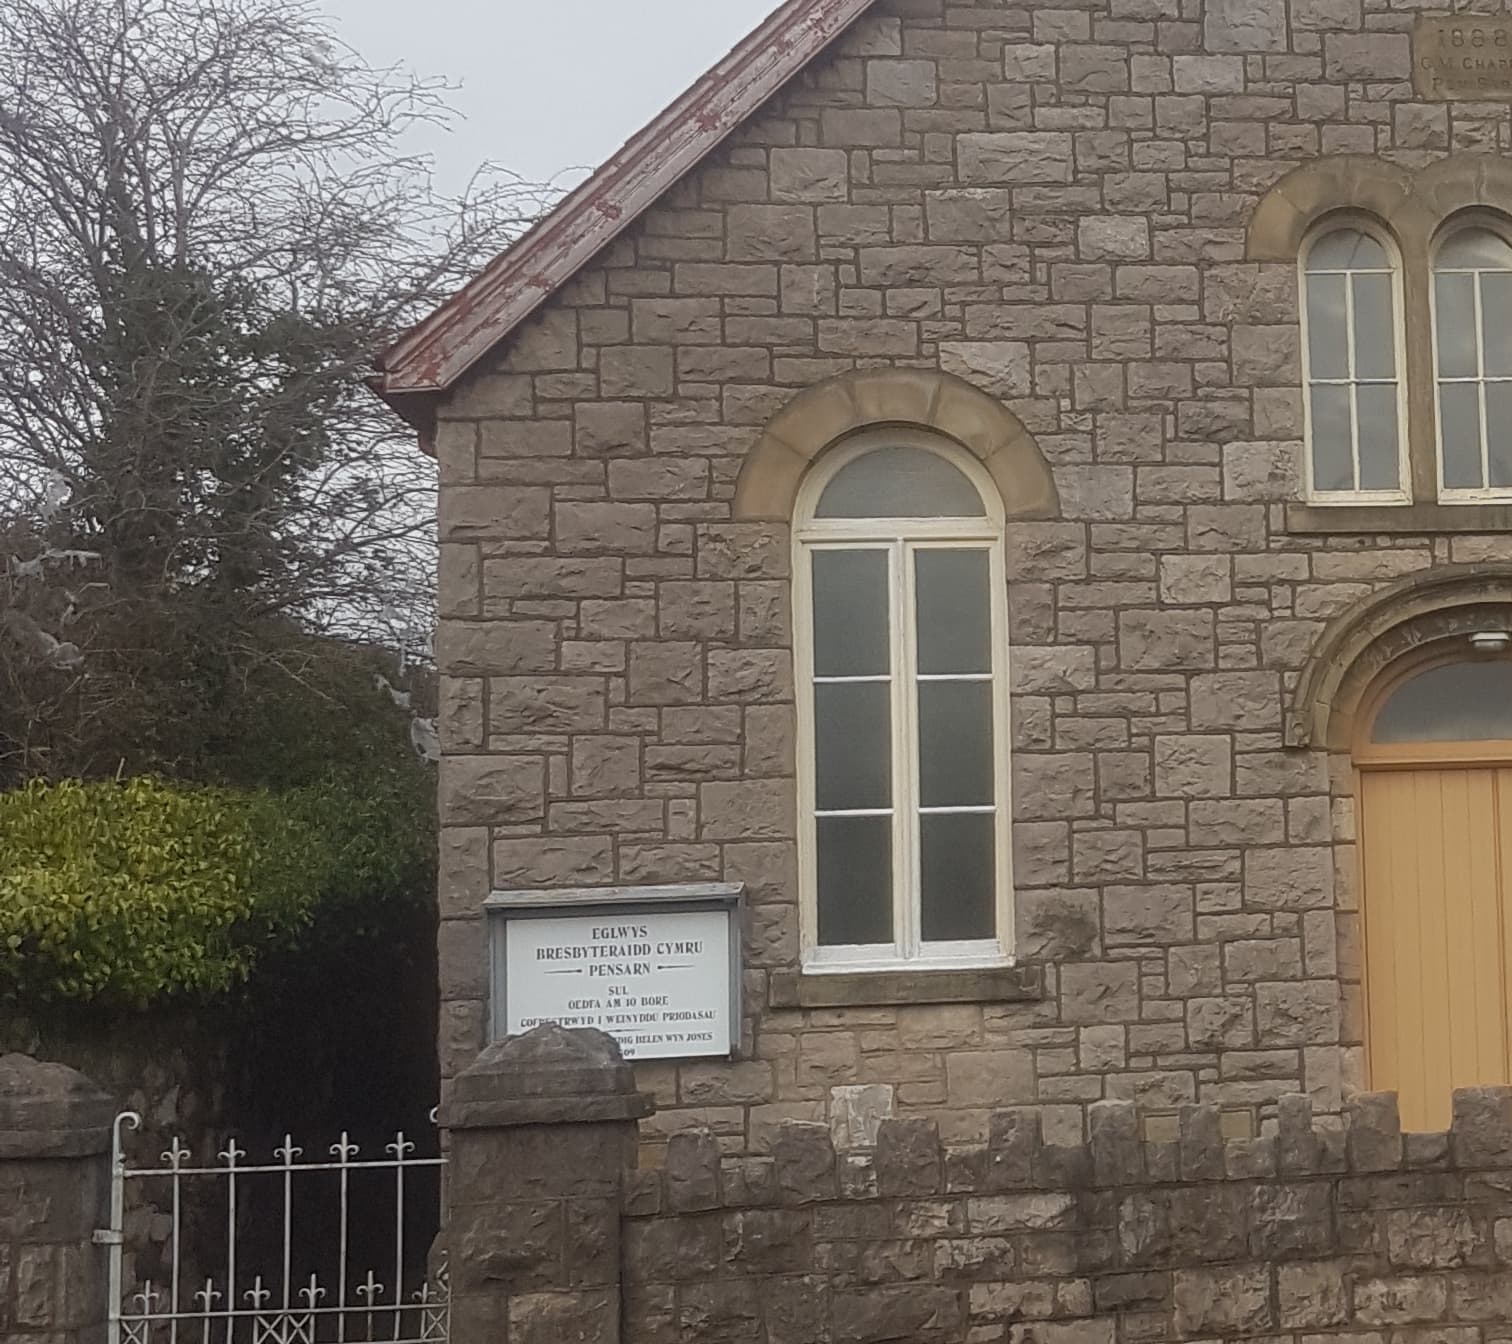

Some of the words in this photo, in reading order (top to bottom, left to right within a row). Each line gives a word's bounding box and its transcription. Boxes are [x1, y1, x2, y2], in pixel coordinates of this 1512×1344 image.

[592, 925, 649, 940] EGLWYS
[536, 944, 652, 960] BRESBYTERAIDD
[656, 941, 704, 955] CYMRU
[589, 962, 651, 977] PENSARN
[608, 985, 629, 996] SUL
[606, 998, 621, 1008] AM
[641, 996, 669, 1007] BORE
[605, 1012, 659, 1024] WEINYDDU
[662, 1010, 716, 1022] PRIODASAU
[635, 1034, 664, 1044] HELEN
[665, 1033, 684, 1043] WYN
[686, 1031, 713, 1041] JONES
